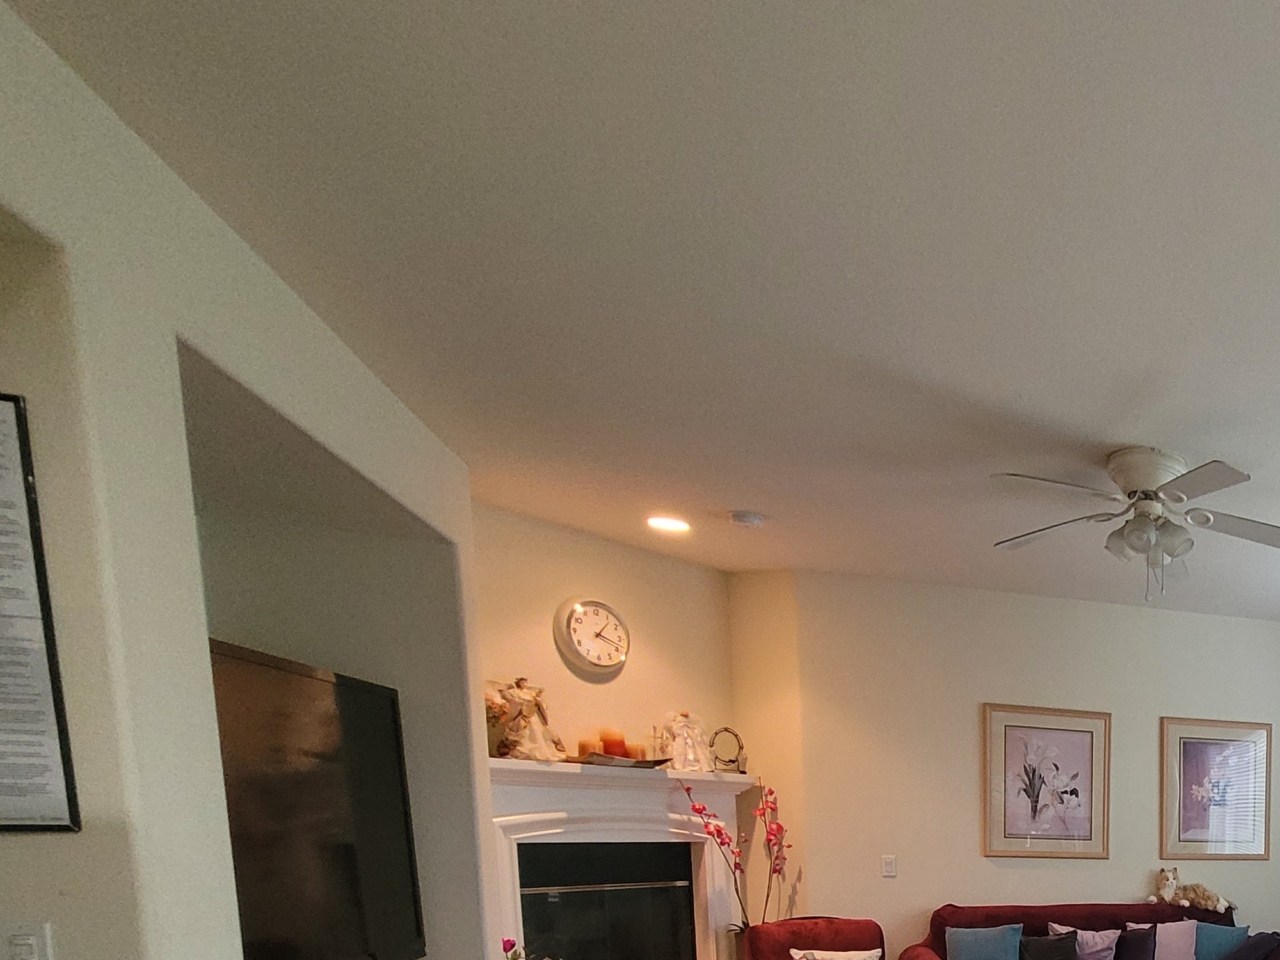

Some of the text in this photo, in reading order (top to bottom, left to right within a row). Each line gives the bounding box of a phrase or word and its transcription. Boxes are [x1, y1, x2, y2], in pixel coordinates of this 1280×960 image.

[593, 608, 599, 616] 12
[614, 623, 618, 631] 2
[577, 639, 582, 647] 8
[617, 635, 621, 643] 3
[607, 652, 612, 660] 5
